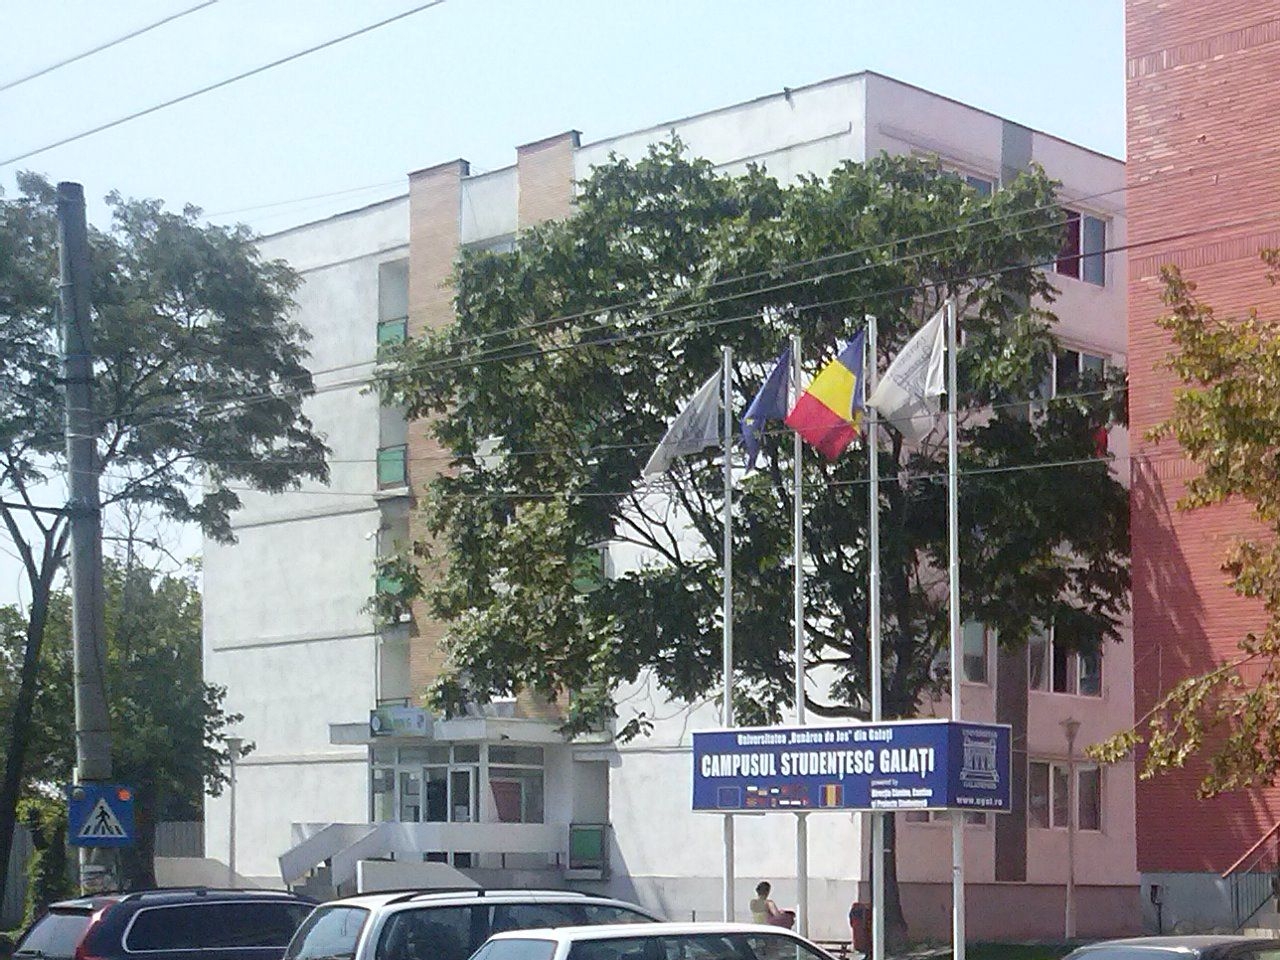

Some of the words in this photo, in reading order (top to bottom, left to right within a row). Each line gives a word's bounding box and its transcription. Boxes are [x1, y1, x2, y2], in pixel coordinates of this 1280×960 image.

[824, 730, 835, 743] de
[853, 728, 867, 742] din
[701, 753, 777, 778] CAMPUSUL
[780, 750, 875, 780] STUDENȚESC
[879, 748, 935, 779] GALAȚI
